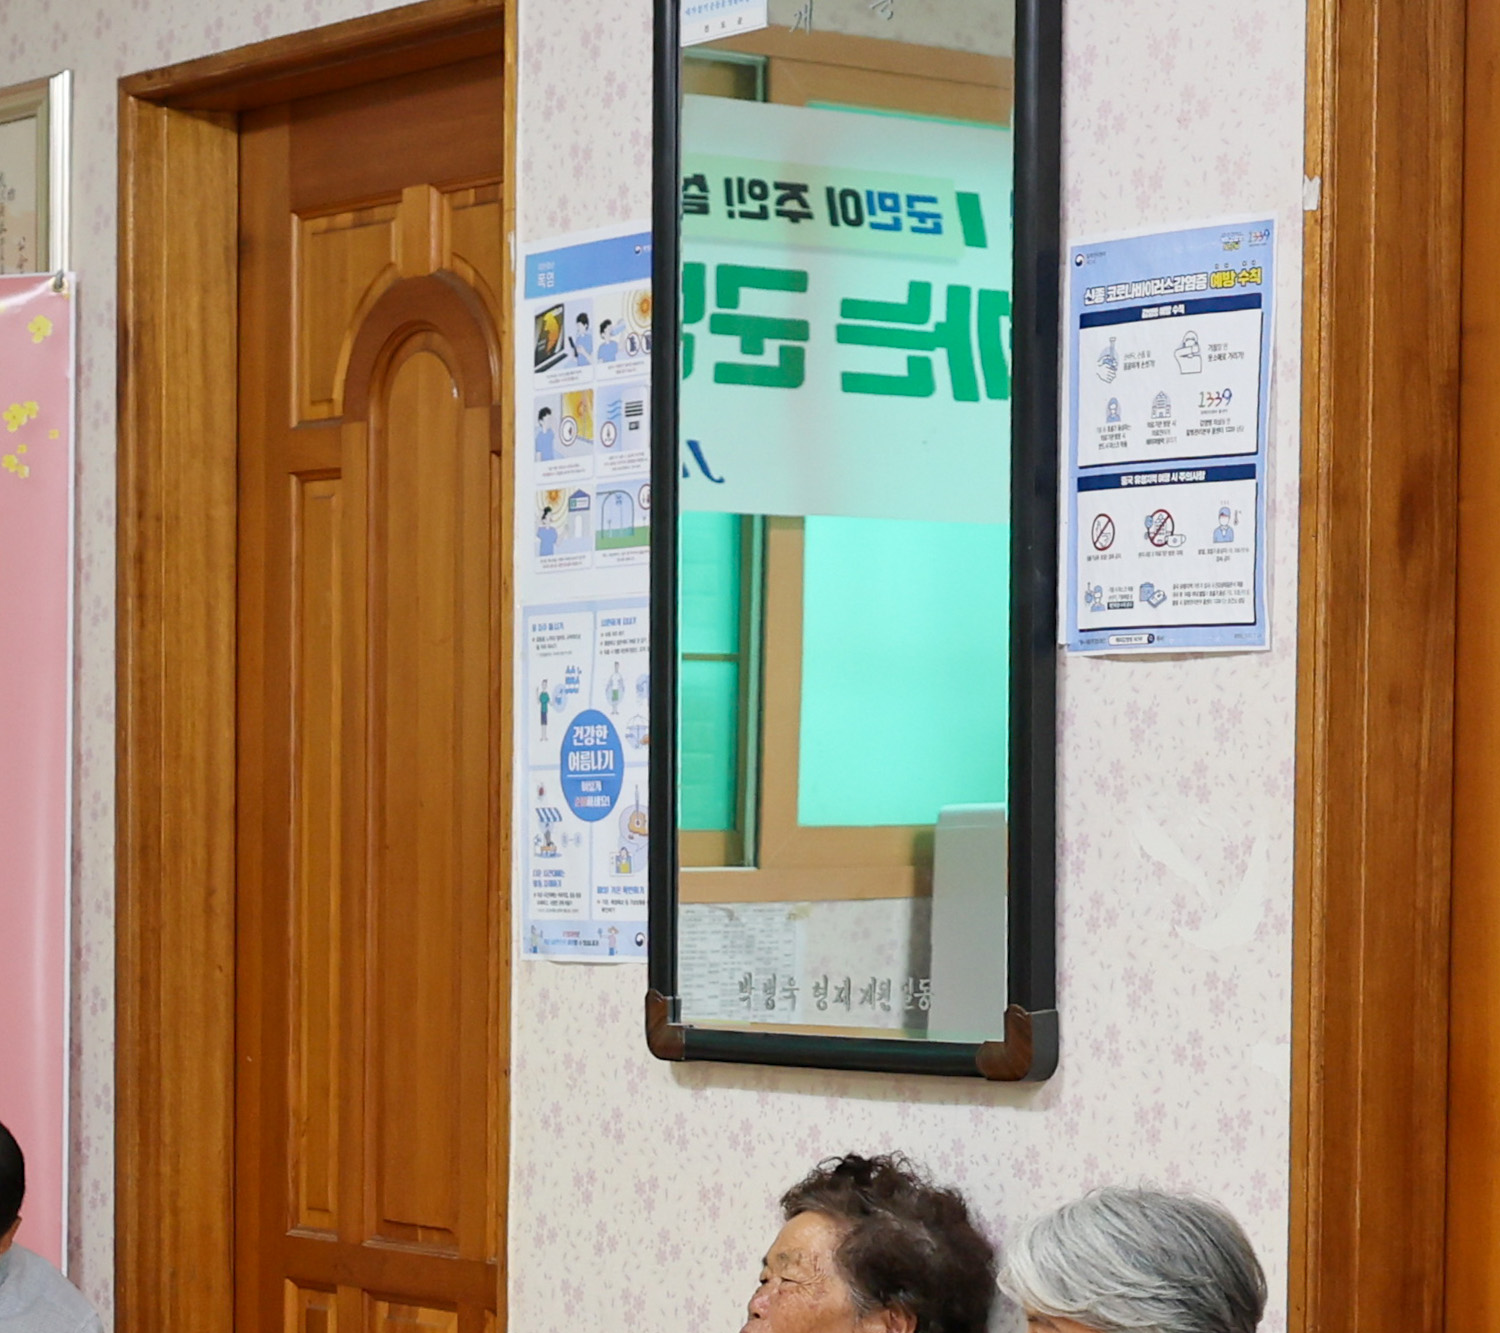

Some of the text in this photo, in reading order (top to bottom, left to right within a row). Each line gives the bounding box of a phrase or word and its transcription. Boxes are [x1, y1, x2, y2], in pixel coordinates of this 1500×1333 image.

[1084, 267, 1262, 306] 신종 코로나바이러스감염증 예방 수칙
[1198, 388, 1233, 408] 1339
[573, 725, 608, 746] 건강한
[568, 750, 613, 771] 여름나기
